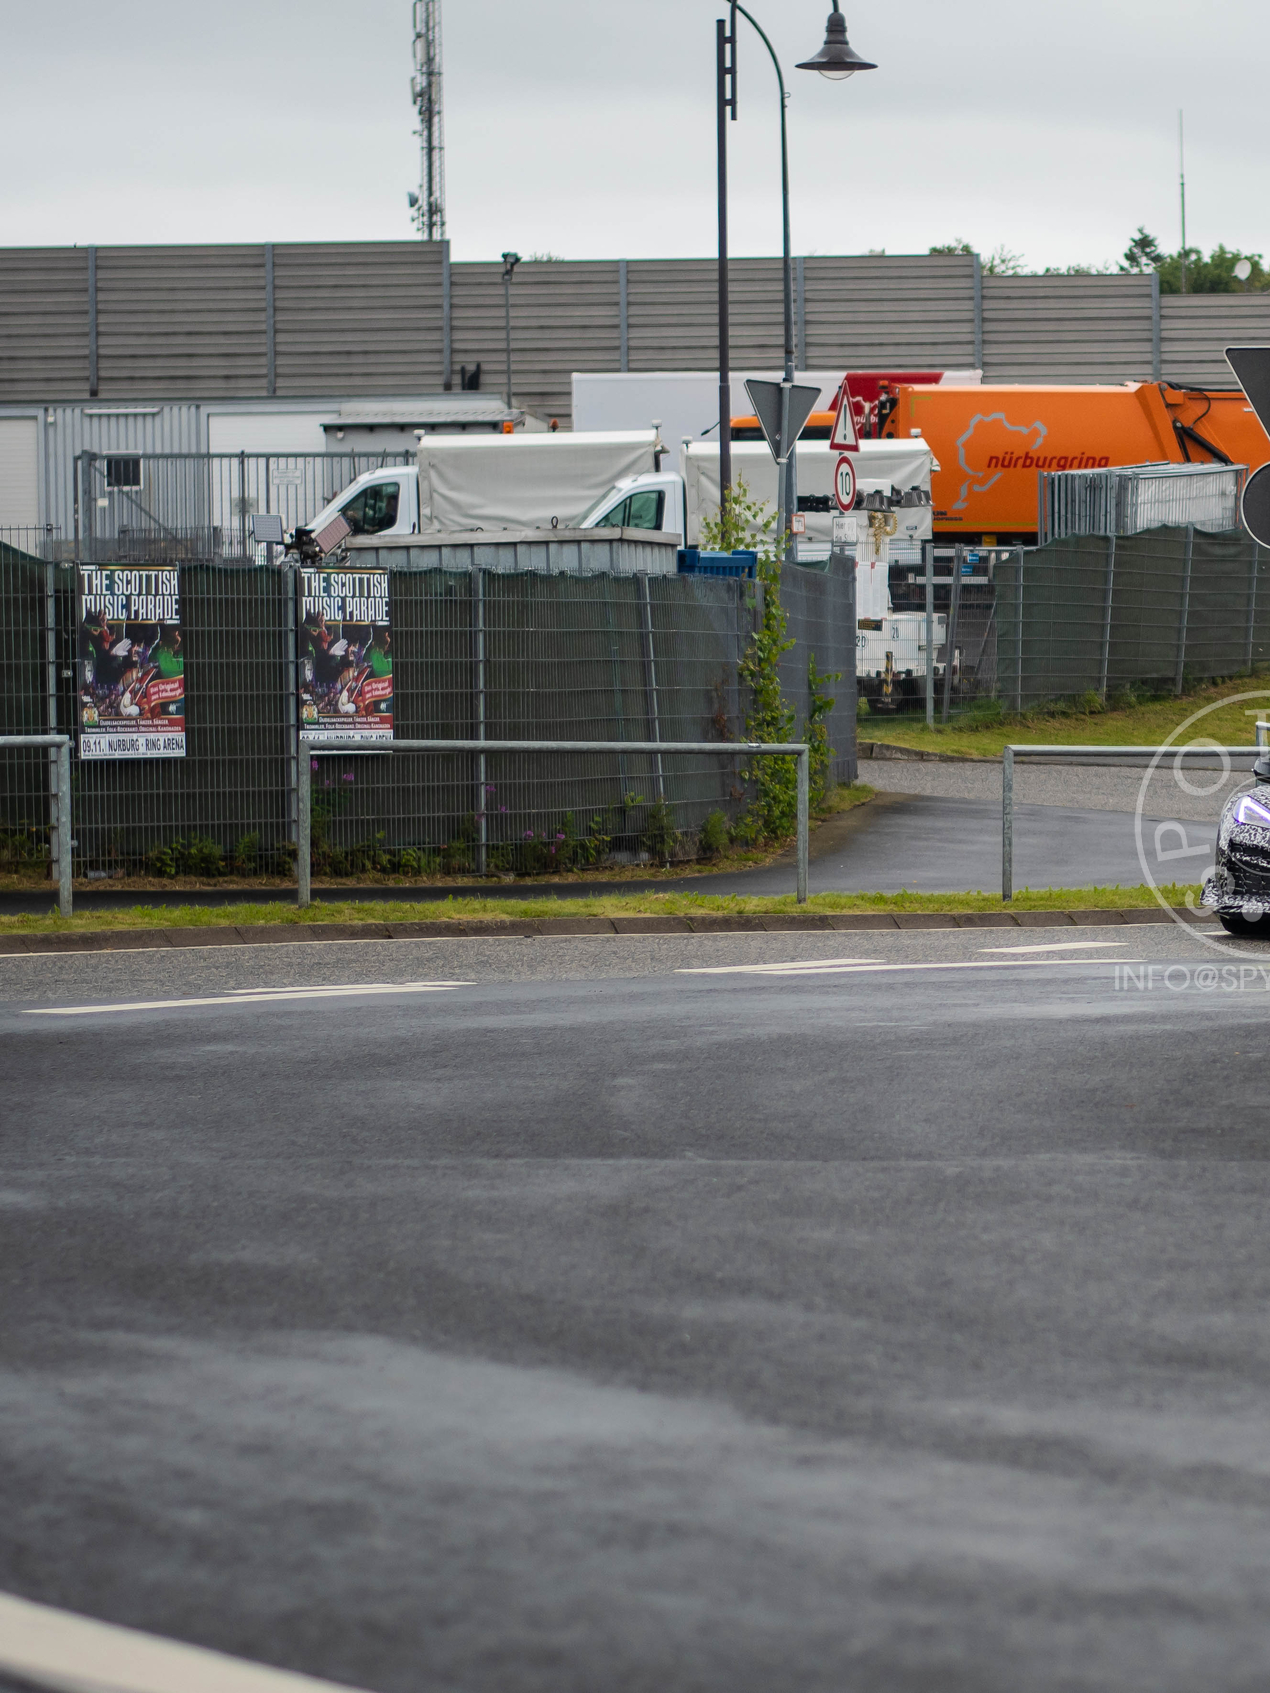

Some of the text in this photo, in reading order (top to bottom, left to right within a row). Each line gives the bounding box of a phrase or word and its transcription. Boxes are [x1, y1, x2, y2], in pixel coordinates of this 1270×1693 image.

[840, 472, 850, 496] 10
[81, 570, 179, 595] THE SCOTTISH
[302, 573, 388, 597] THE SCOTTISH
[82, 595, 180, 622] MUSIC PARADE
[302, 597, 390, 623] MUSIC PARADE
[82, 740, 104, 753] 09.11.
[145, 738, 161, 751] RING
[163, 738, 185, 751] ARENA
